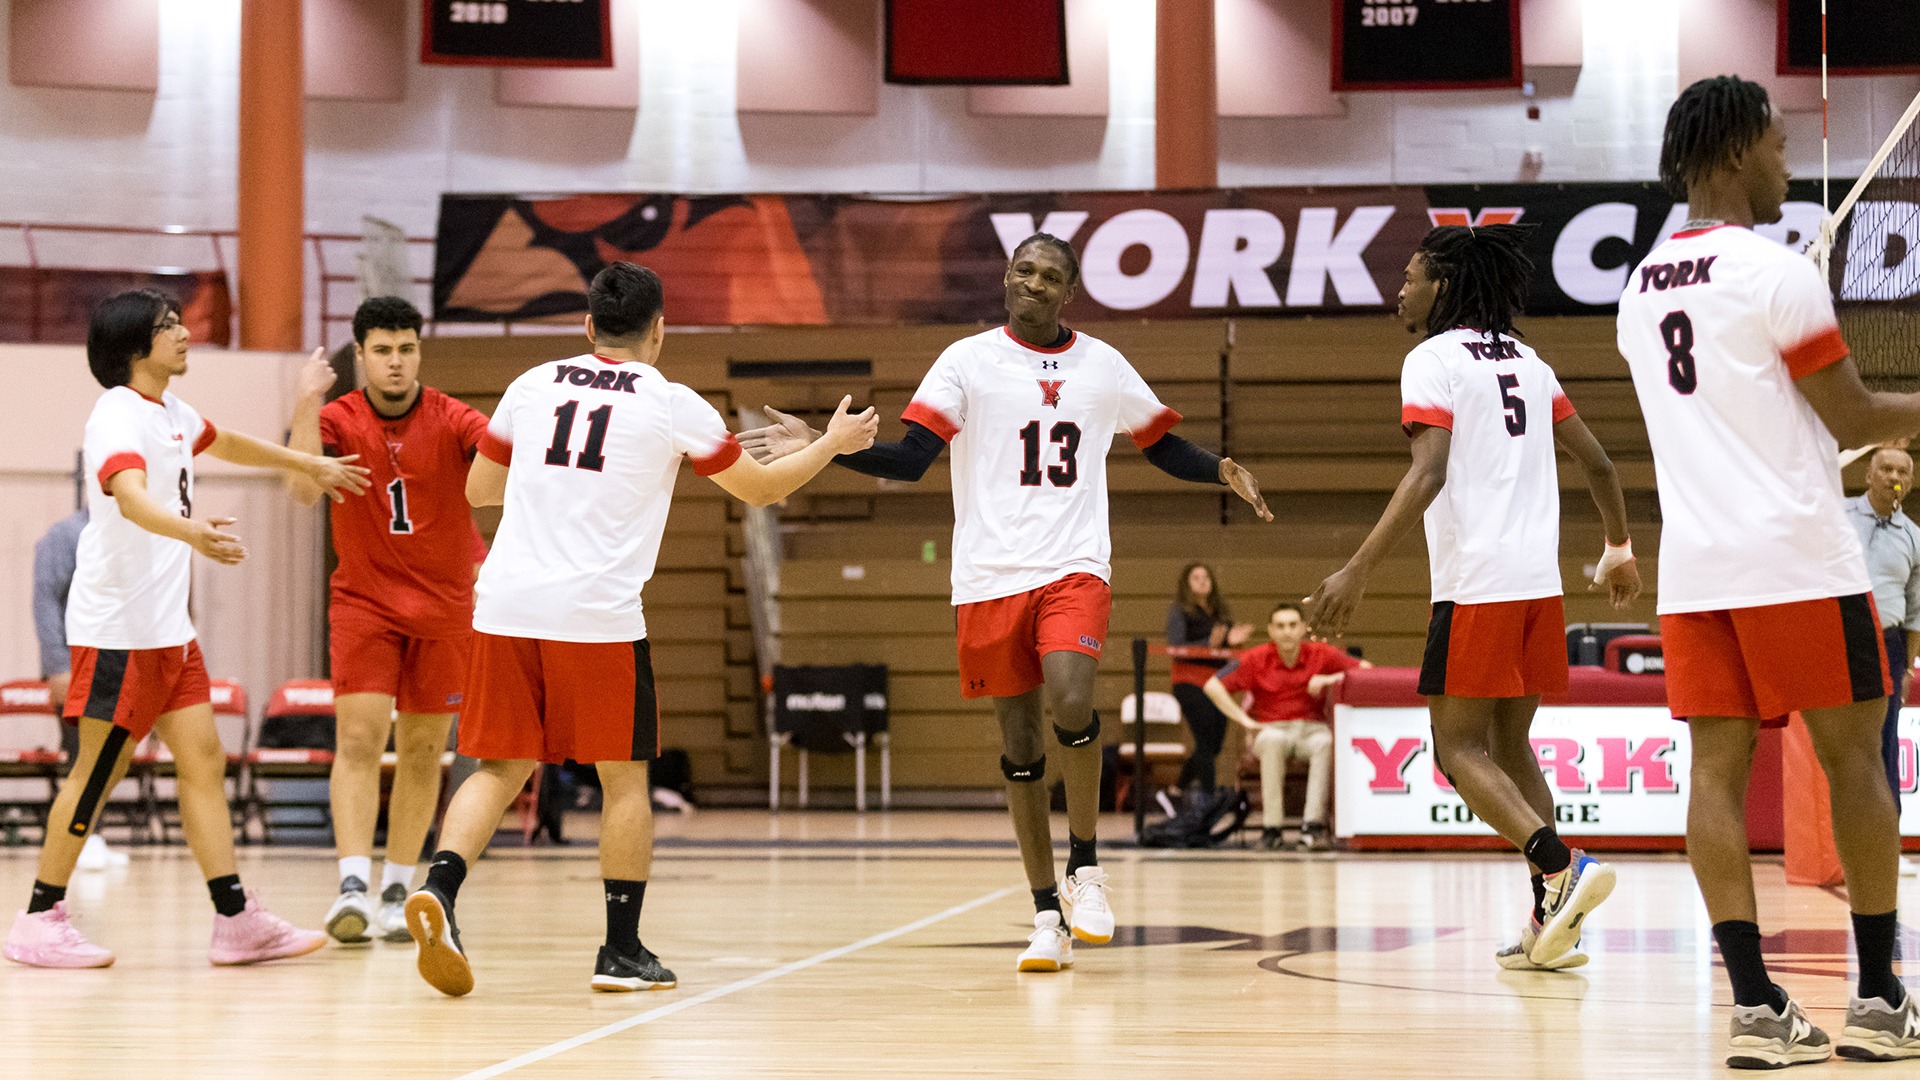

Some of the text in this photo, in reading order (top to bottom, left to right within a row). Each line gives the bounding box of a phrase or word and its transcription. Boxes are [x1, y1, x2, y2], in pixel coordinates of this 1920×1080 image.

[1361, 6, 1419, 26] 2007
[990, 205, 1396, 311] YORK
[1639, 255, 1718, 293] YORK
[1461, 340, 1523, 361] YORK
[1660, 310, 1697, 395] 8
[553, 365, 643, 394] YORK
[1496, 373, 1526, 437] 5
[544, 399, 613, 472] 11
[1019, 420, 1082, 488] 13
[386, 477, 414, 534] 1
[1352, 738, 1679, 794] YRK
[1431, 804, 1600, 824] COGE
